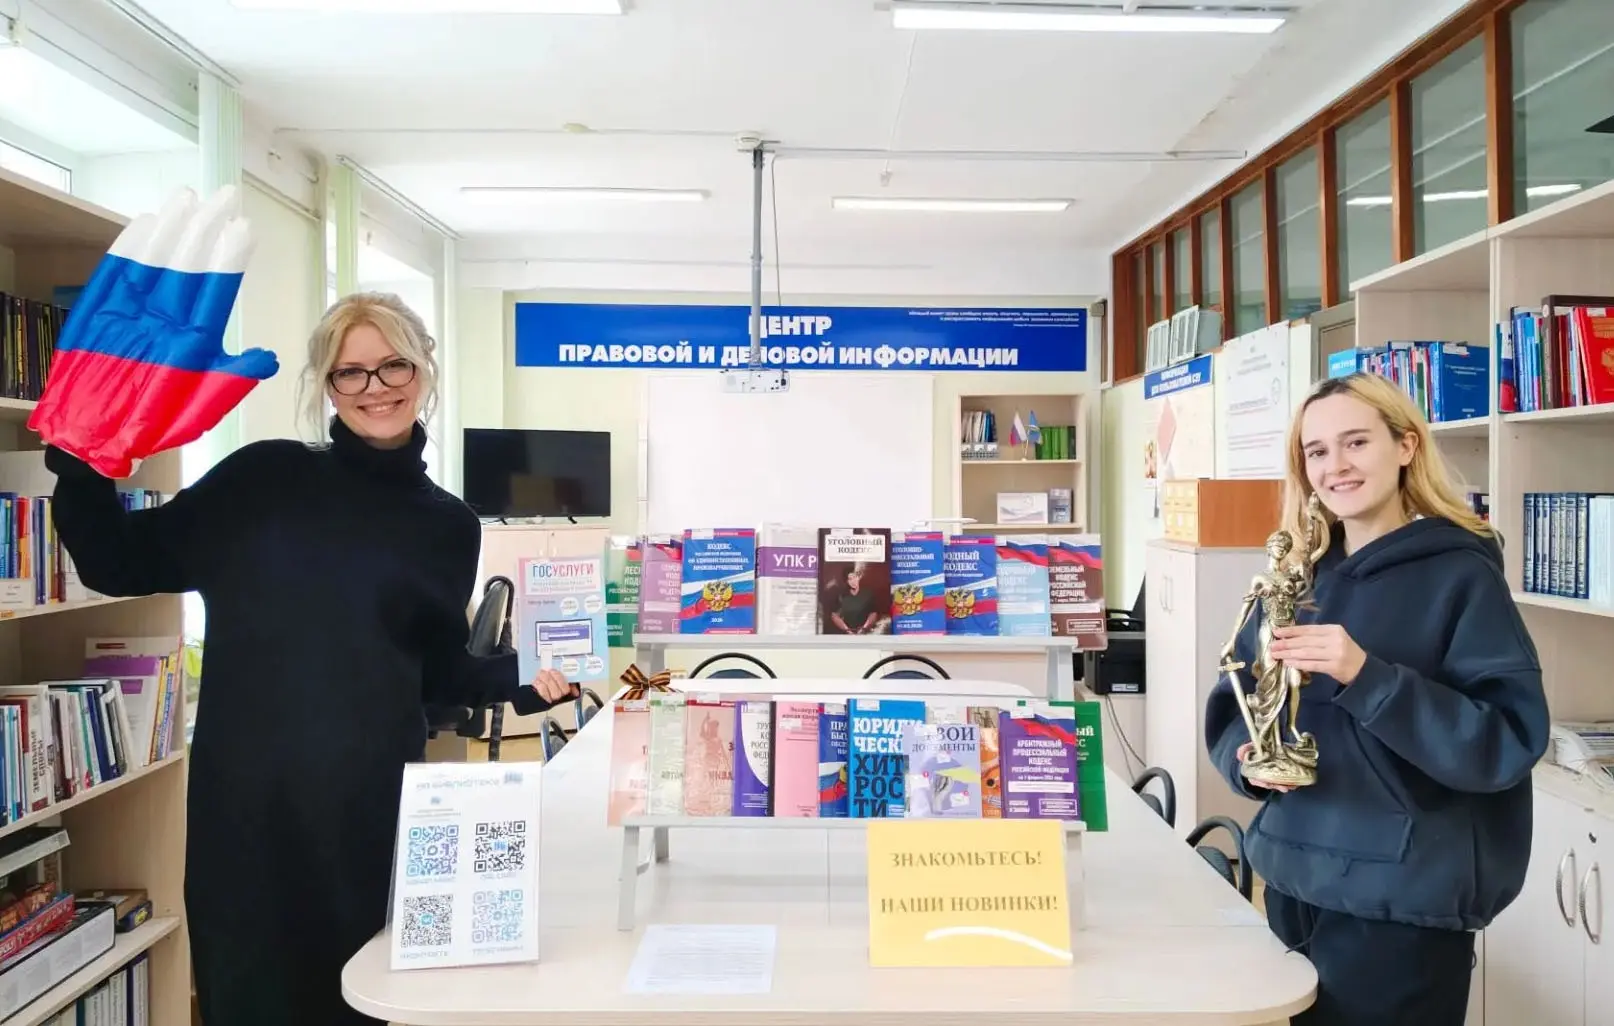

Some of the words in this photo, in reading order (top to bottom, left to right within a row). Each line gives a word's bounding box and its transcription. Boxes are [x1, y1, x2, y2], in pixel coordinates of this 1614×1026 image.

[749, 315, 832, 339] ЦЕНТР
[559, 341, 693, 364] ПРАВОВОЙ
[698, 345, 715, 364] И
[839, 344, 1018, 368] ИНФОРМАЦИИ
[828, 537, 882, 546] УГОЛОВНЫЙ
[773, 554, 804, 568] УПК
[808, 555, 817, 568] Р
[532, 563, 594, 578] ГОСУСЛУГИ
[912, 742, 977, 753] ДОМЕНТЫ
[853, 799, 889, 818] ТИ
[889, 850, 1042, 868] ЗНАКОМЬТЕСЬ!
[881, 897, 944, 914] НАШИ
[951, 895, 1058, 912] НОВИНКИ!
